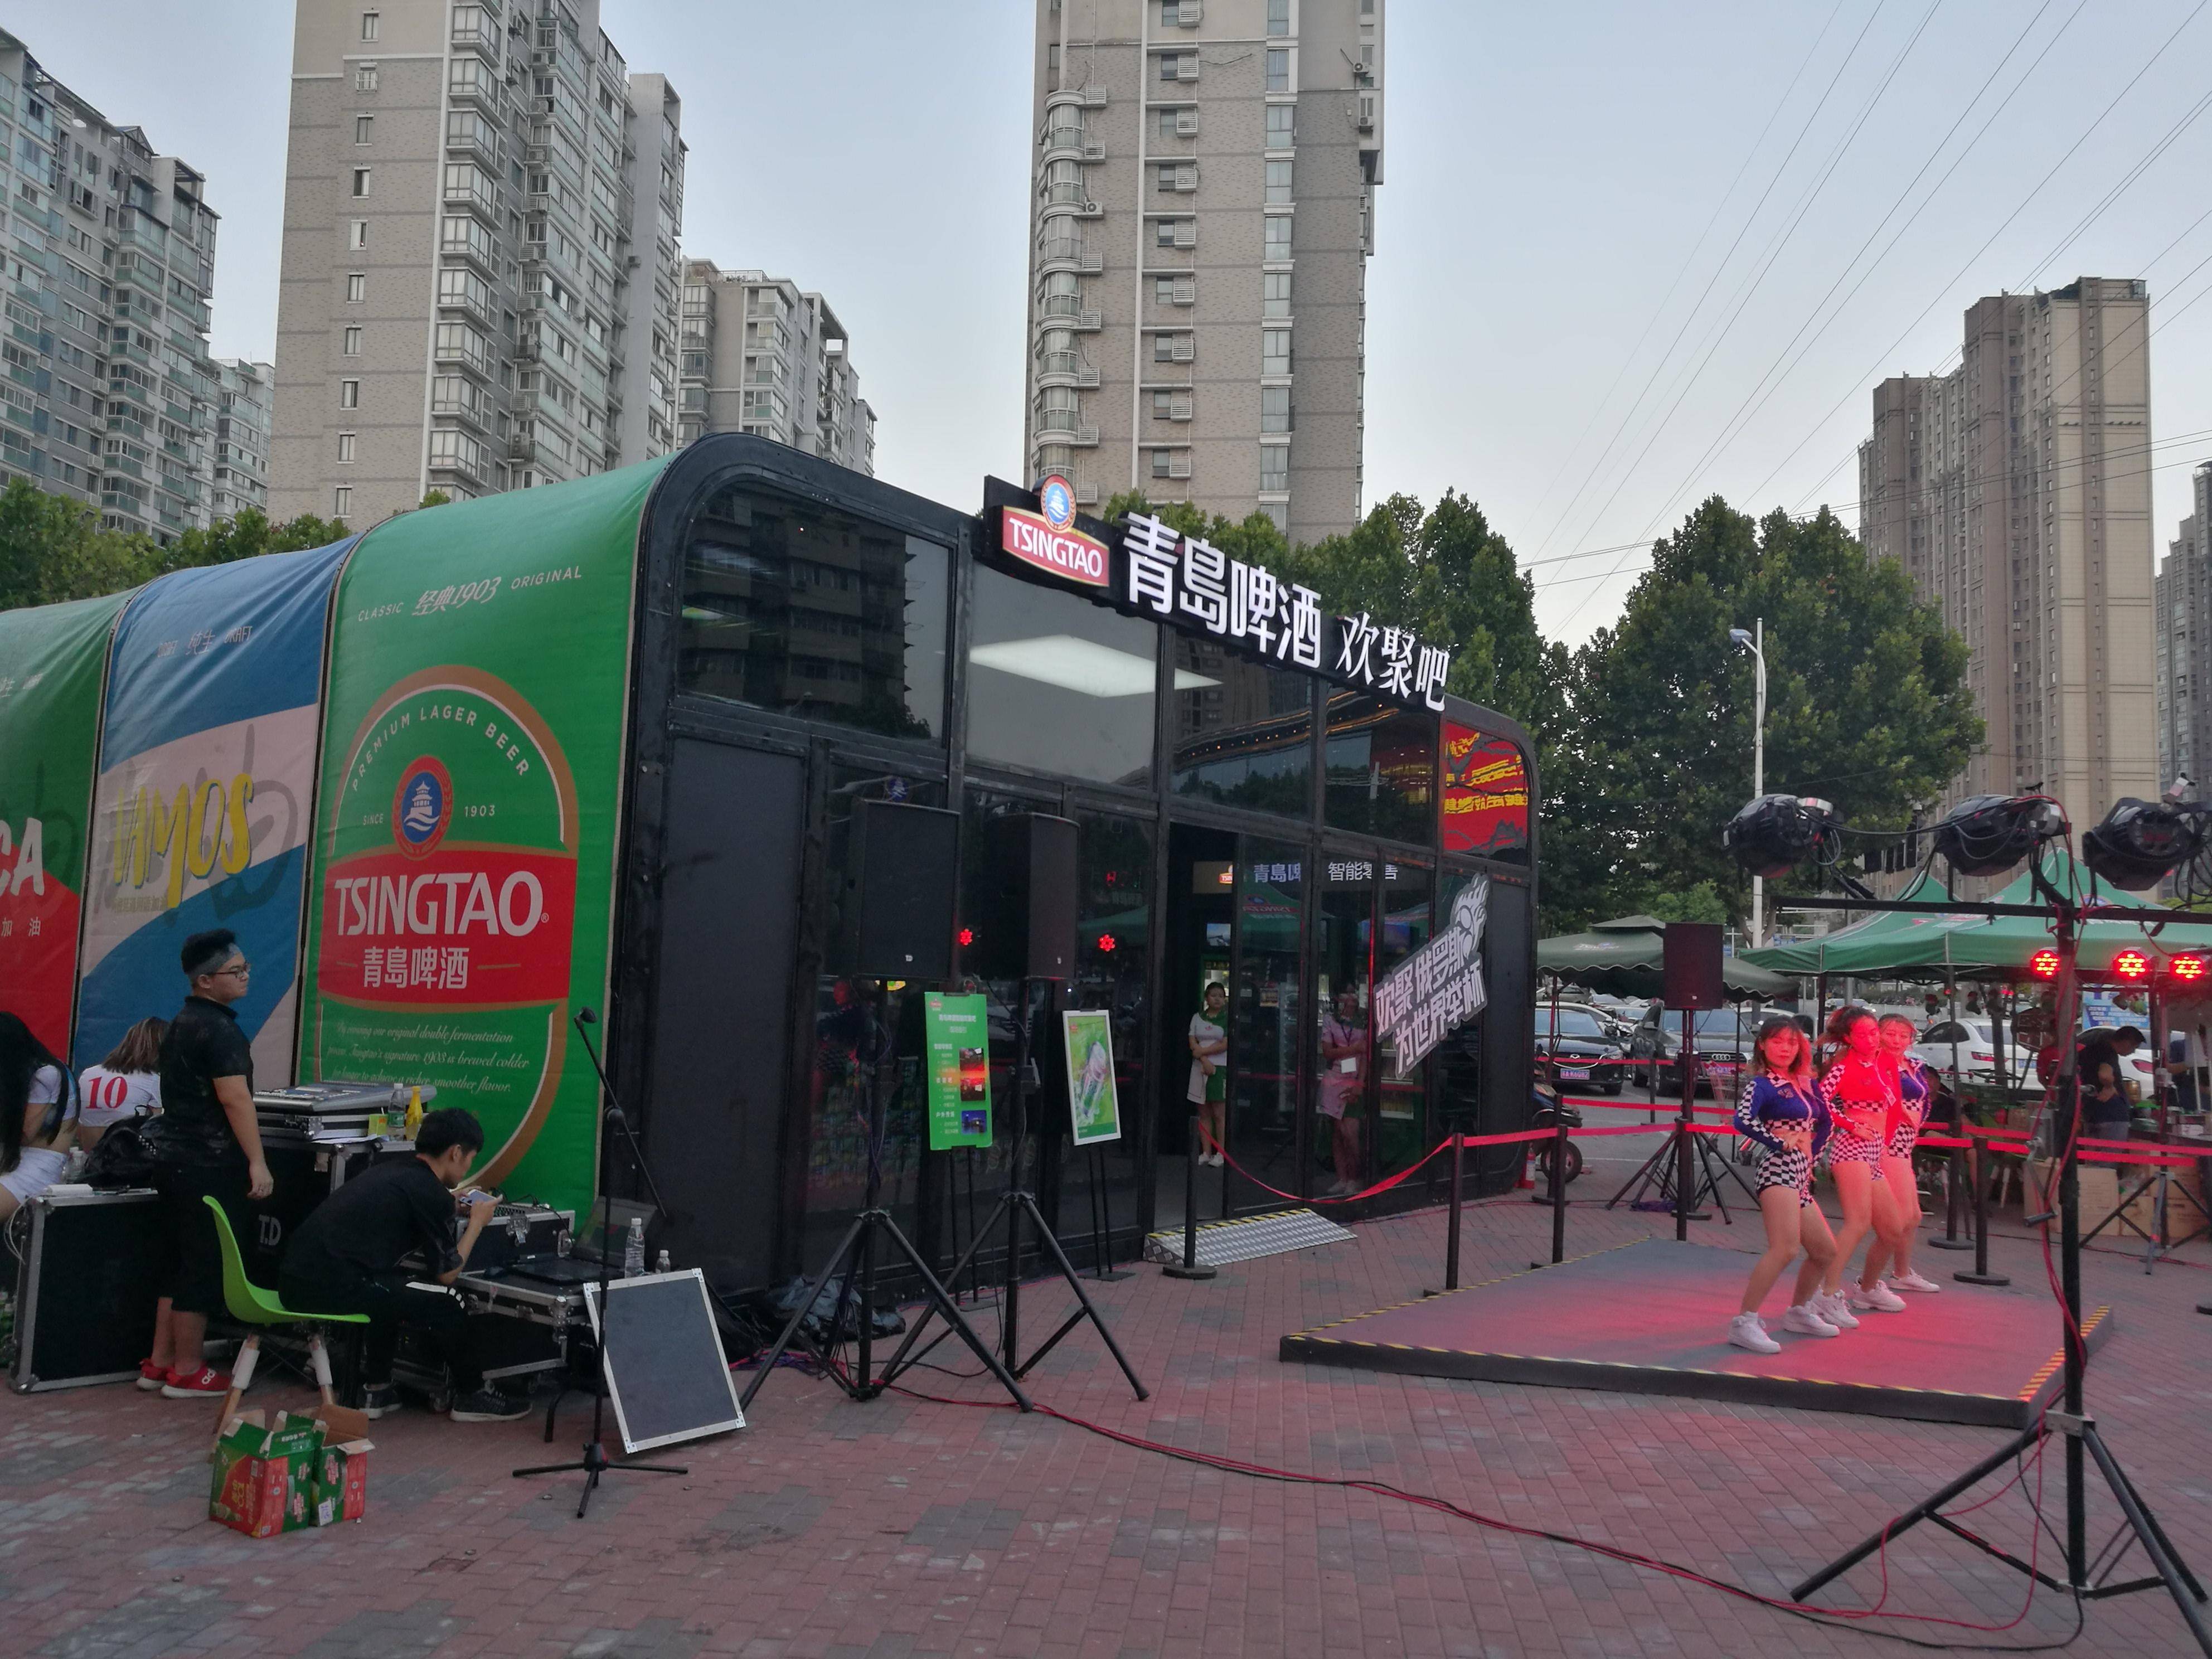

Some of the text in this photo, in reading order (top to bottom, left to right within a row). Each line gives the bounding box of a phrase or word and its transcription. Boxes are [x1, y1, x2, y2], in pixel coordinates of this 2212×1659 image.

[1008, 516, 1103, 578] TSINGTAO
[358, 601, 404, 622] CLASSIC
[511, 565, 583, 590] ORIGINAL
[1335, 612, 1449, 712] 欢聚吧
[352, 705, 530, 792] PREMIUM LAGER BEER
[362, 813, 384, 826] SINCE
[464, 804, 496, 817] 1903
[334, 870, 543, 937] TSINGTAO
[363, 946, 469, 989] 青島啤酒
[1376, 926, 1466, 1036] 欢聚俄罗斯
[387, 1024, 420, 1041] original
[419, 1024, 449, 1040] double
[444, 1026, 513, 1045] fermentation
[1395, 959, 1485, 1074] 为世界举杯
[447, 1054, 456, 1064] is
[457, 1050, 497, 1068] brewed
[496, 1053, 530, 1069] colder
[85, 1076, 128, 1109] 10
